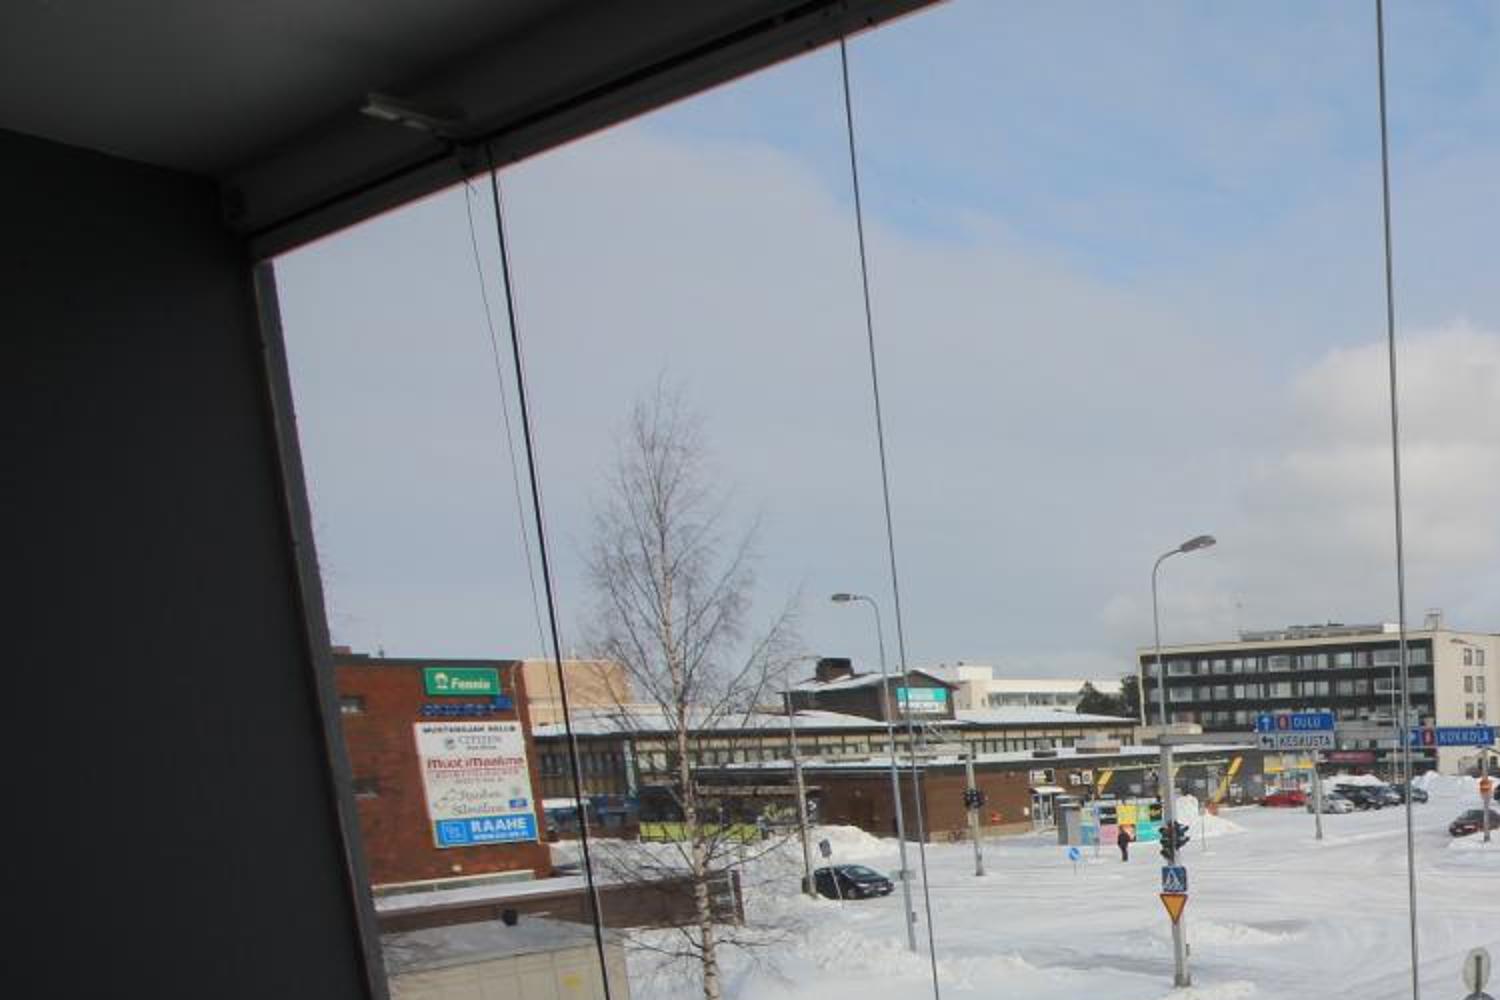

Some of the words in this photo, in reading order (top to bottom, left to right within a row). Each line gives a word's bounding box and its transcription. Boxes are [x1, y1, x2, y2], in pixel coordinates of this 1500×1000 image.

[451, 677, 491, 689] Fennia
[1294, 716, 1320, 728] OULU
[1280, 734, 1331, 746] KESKUSTA
[1439, 731, 1488, 743] KOKKOLA
[471, 817, 528, 833] RAAHE
